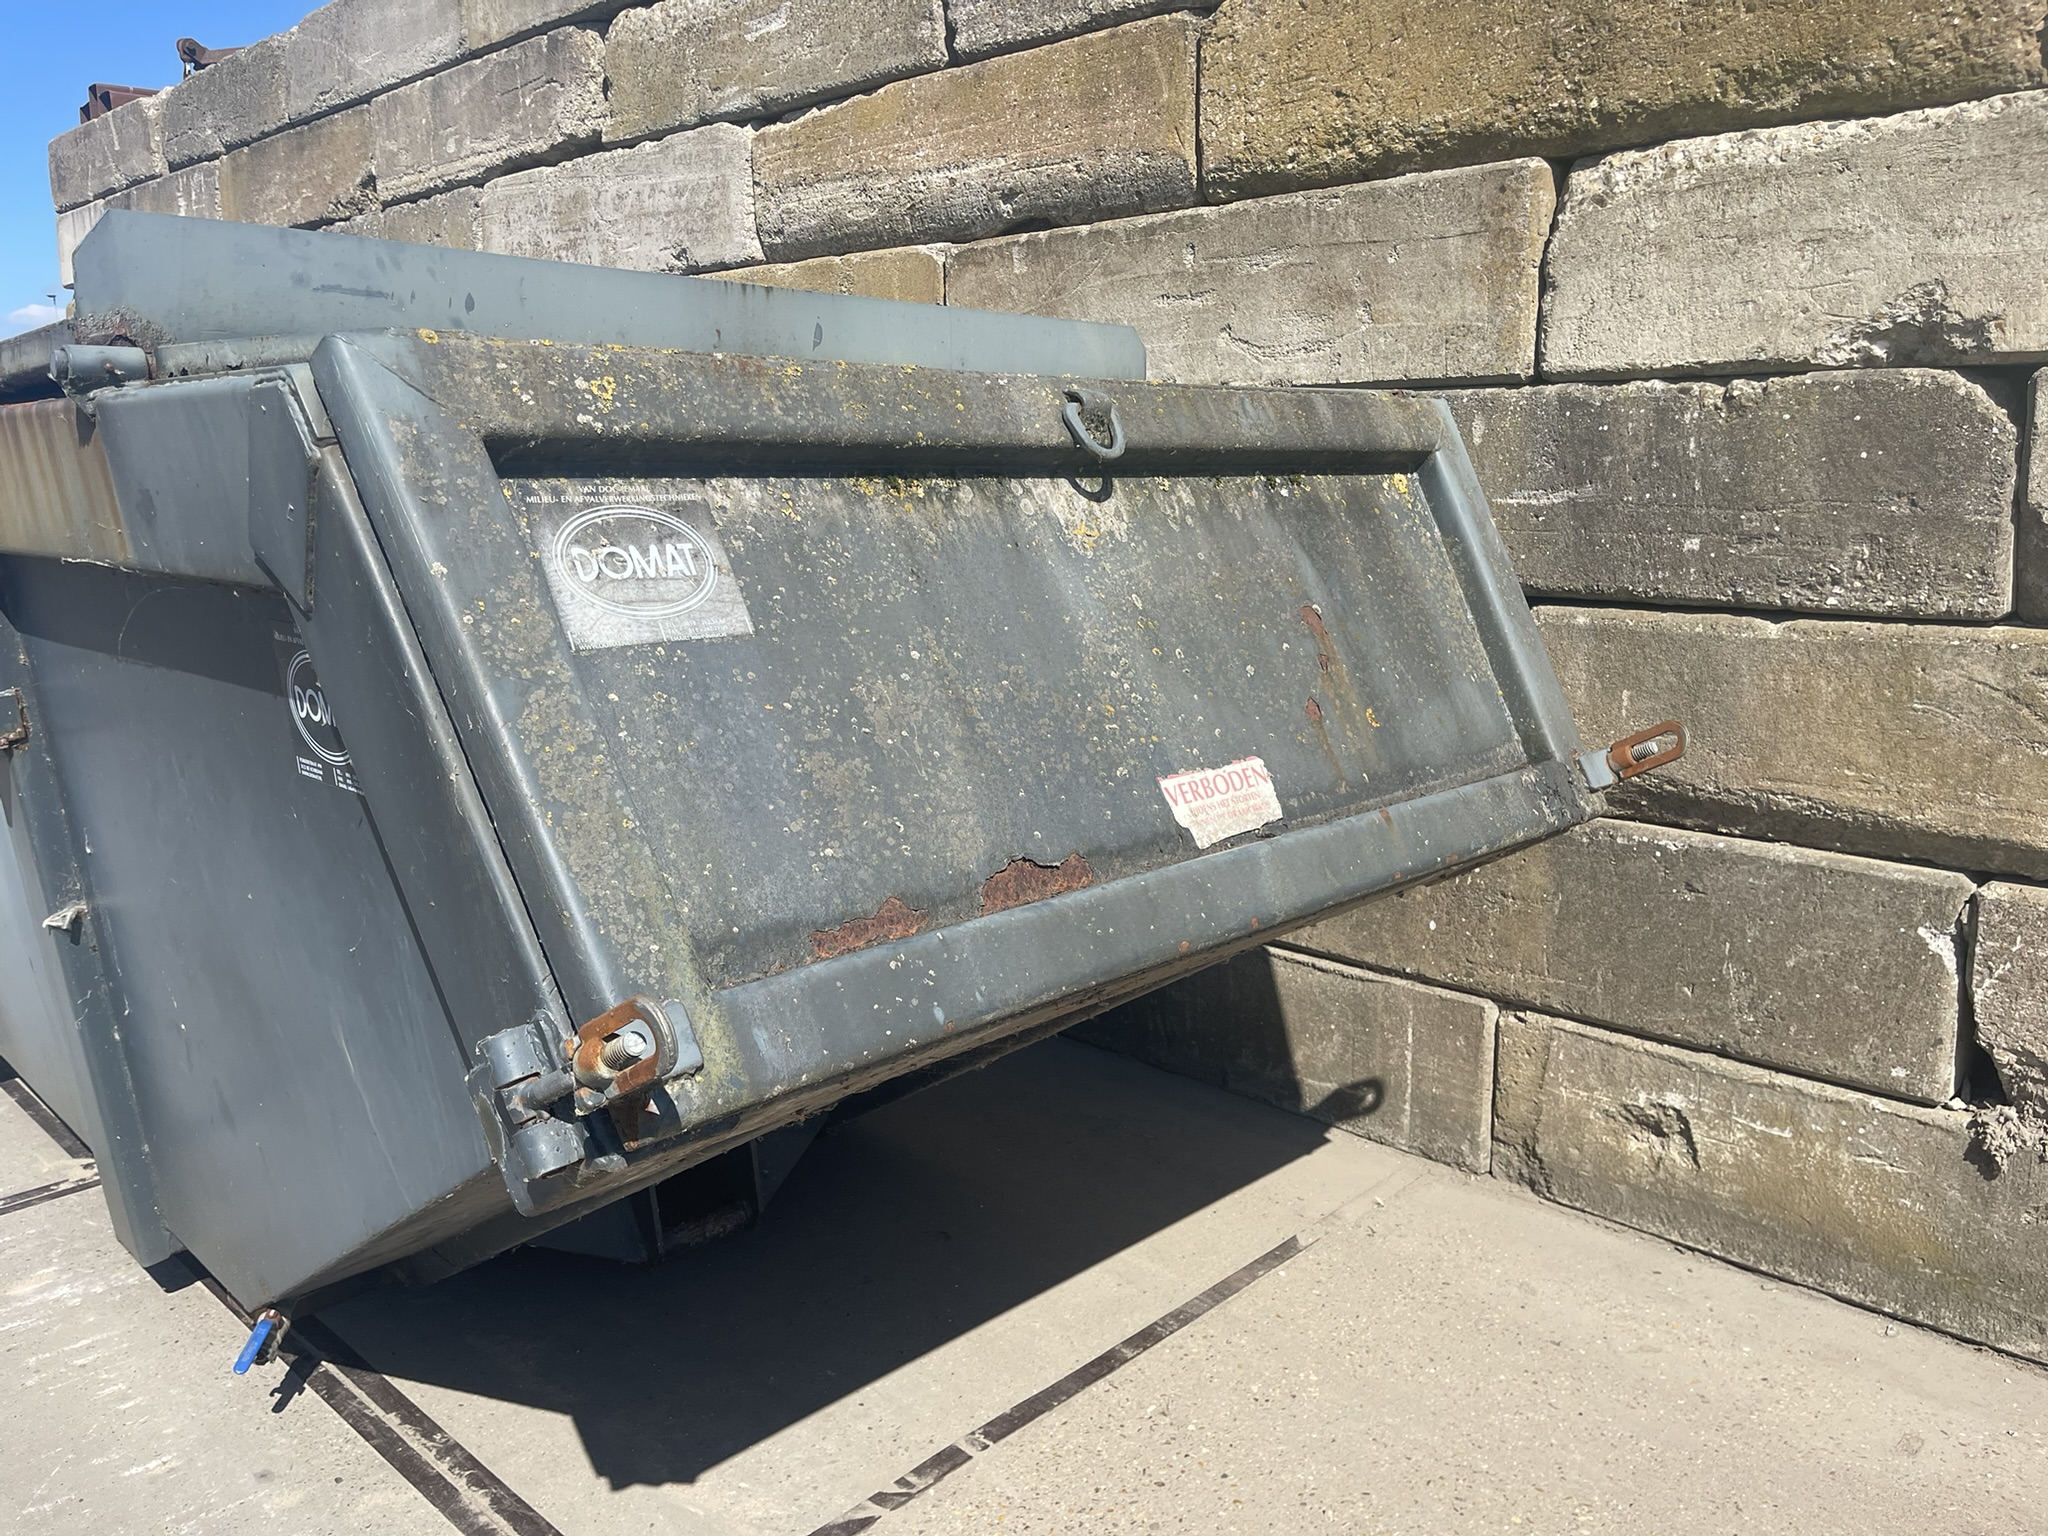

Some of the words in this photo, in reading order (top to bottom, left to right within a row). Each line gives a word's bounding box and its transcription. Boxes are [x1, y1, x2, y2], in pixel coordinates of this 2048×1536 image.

[560, 495, 573, 503] EN
[571, 542, 698, 583] DOMAT
[1163, 764, 1269, 807] VERBODEN
